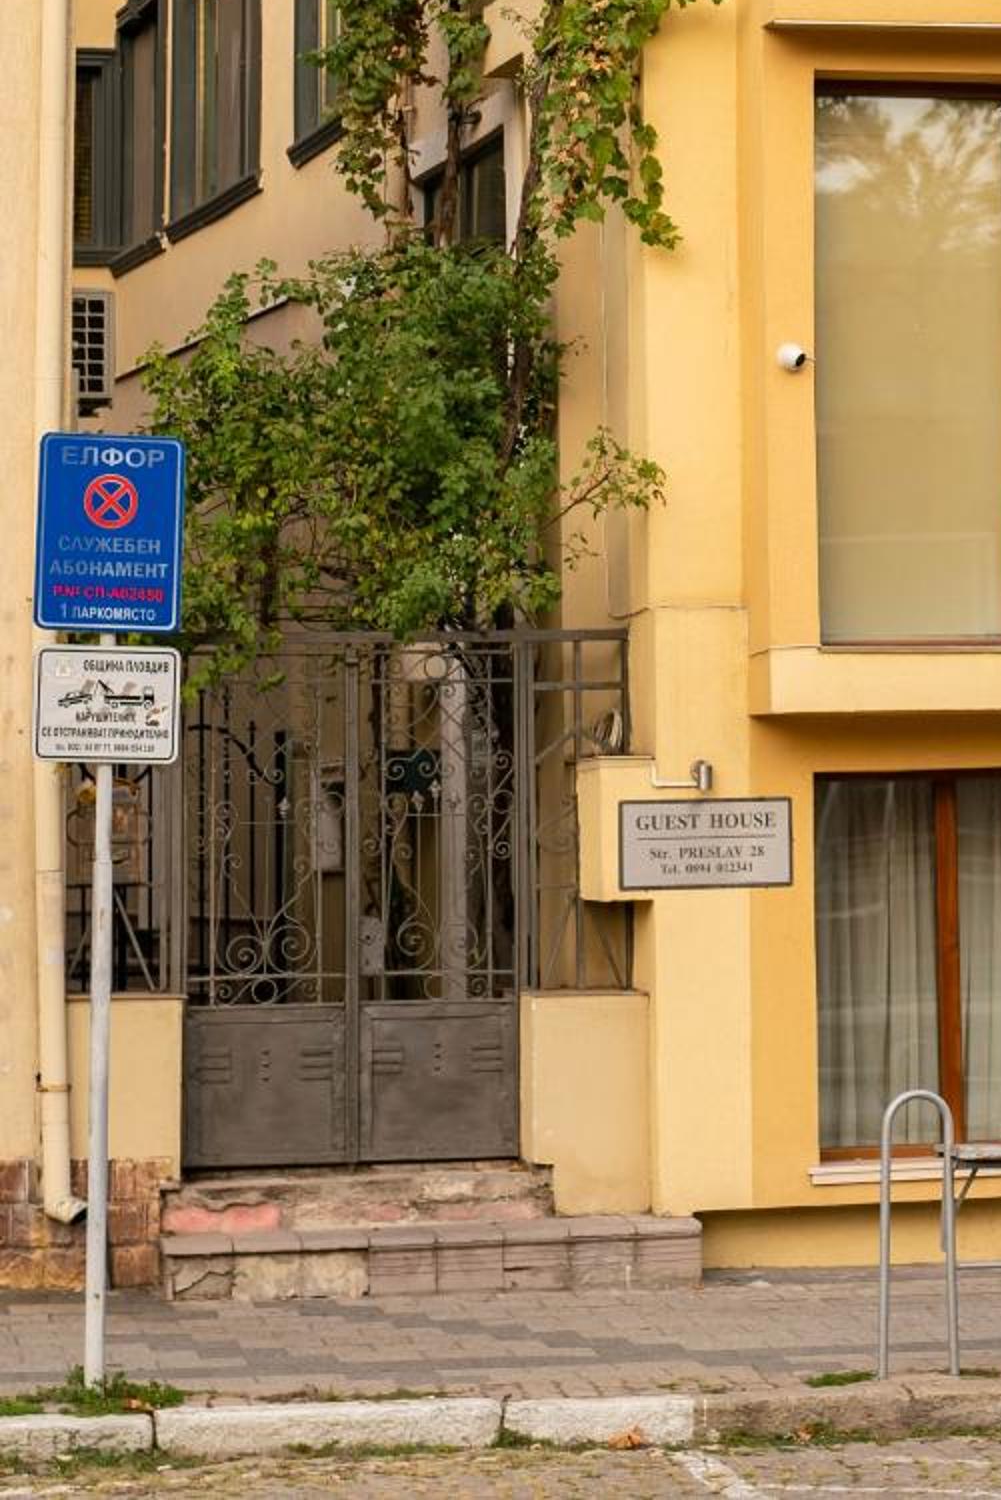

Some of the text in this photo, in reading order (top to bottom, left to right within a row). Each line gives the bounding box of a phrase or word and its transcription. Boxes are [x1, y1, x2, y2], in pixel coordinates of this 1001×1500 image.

[61, 446, 165, 467] ЕЛФОР
[58, 535, 161, 555] СЛУЖЕБЕН
[49, 560, 169, 579] АБОНАМЕНТ
[58, 603, 157, 622] 1 ПАРКОМЯСТО
[83, 659, 170, 674] ОБЩИНА ПЛОВДИВ
[635, 811, 777, 831] GUEST HOUSE
[649, 845, 765, 861] Str. PRESLAV 28
[660, 863, 681, 875] Tel.
